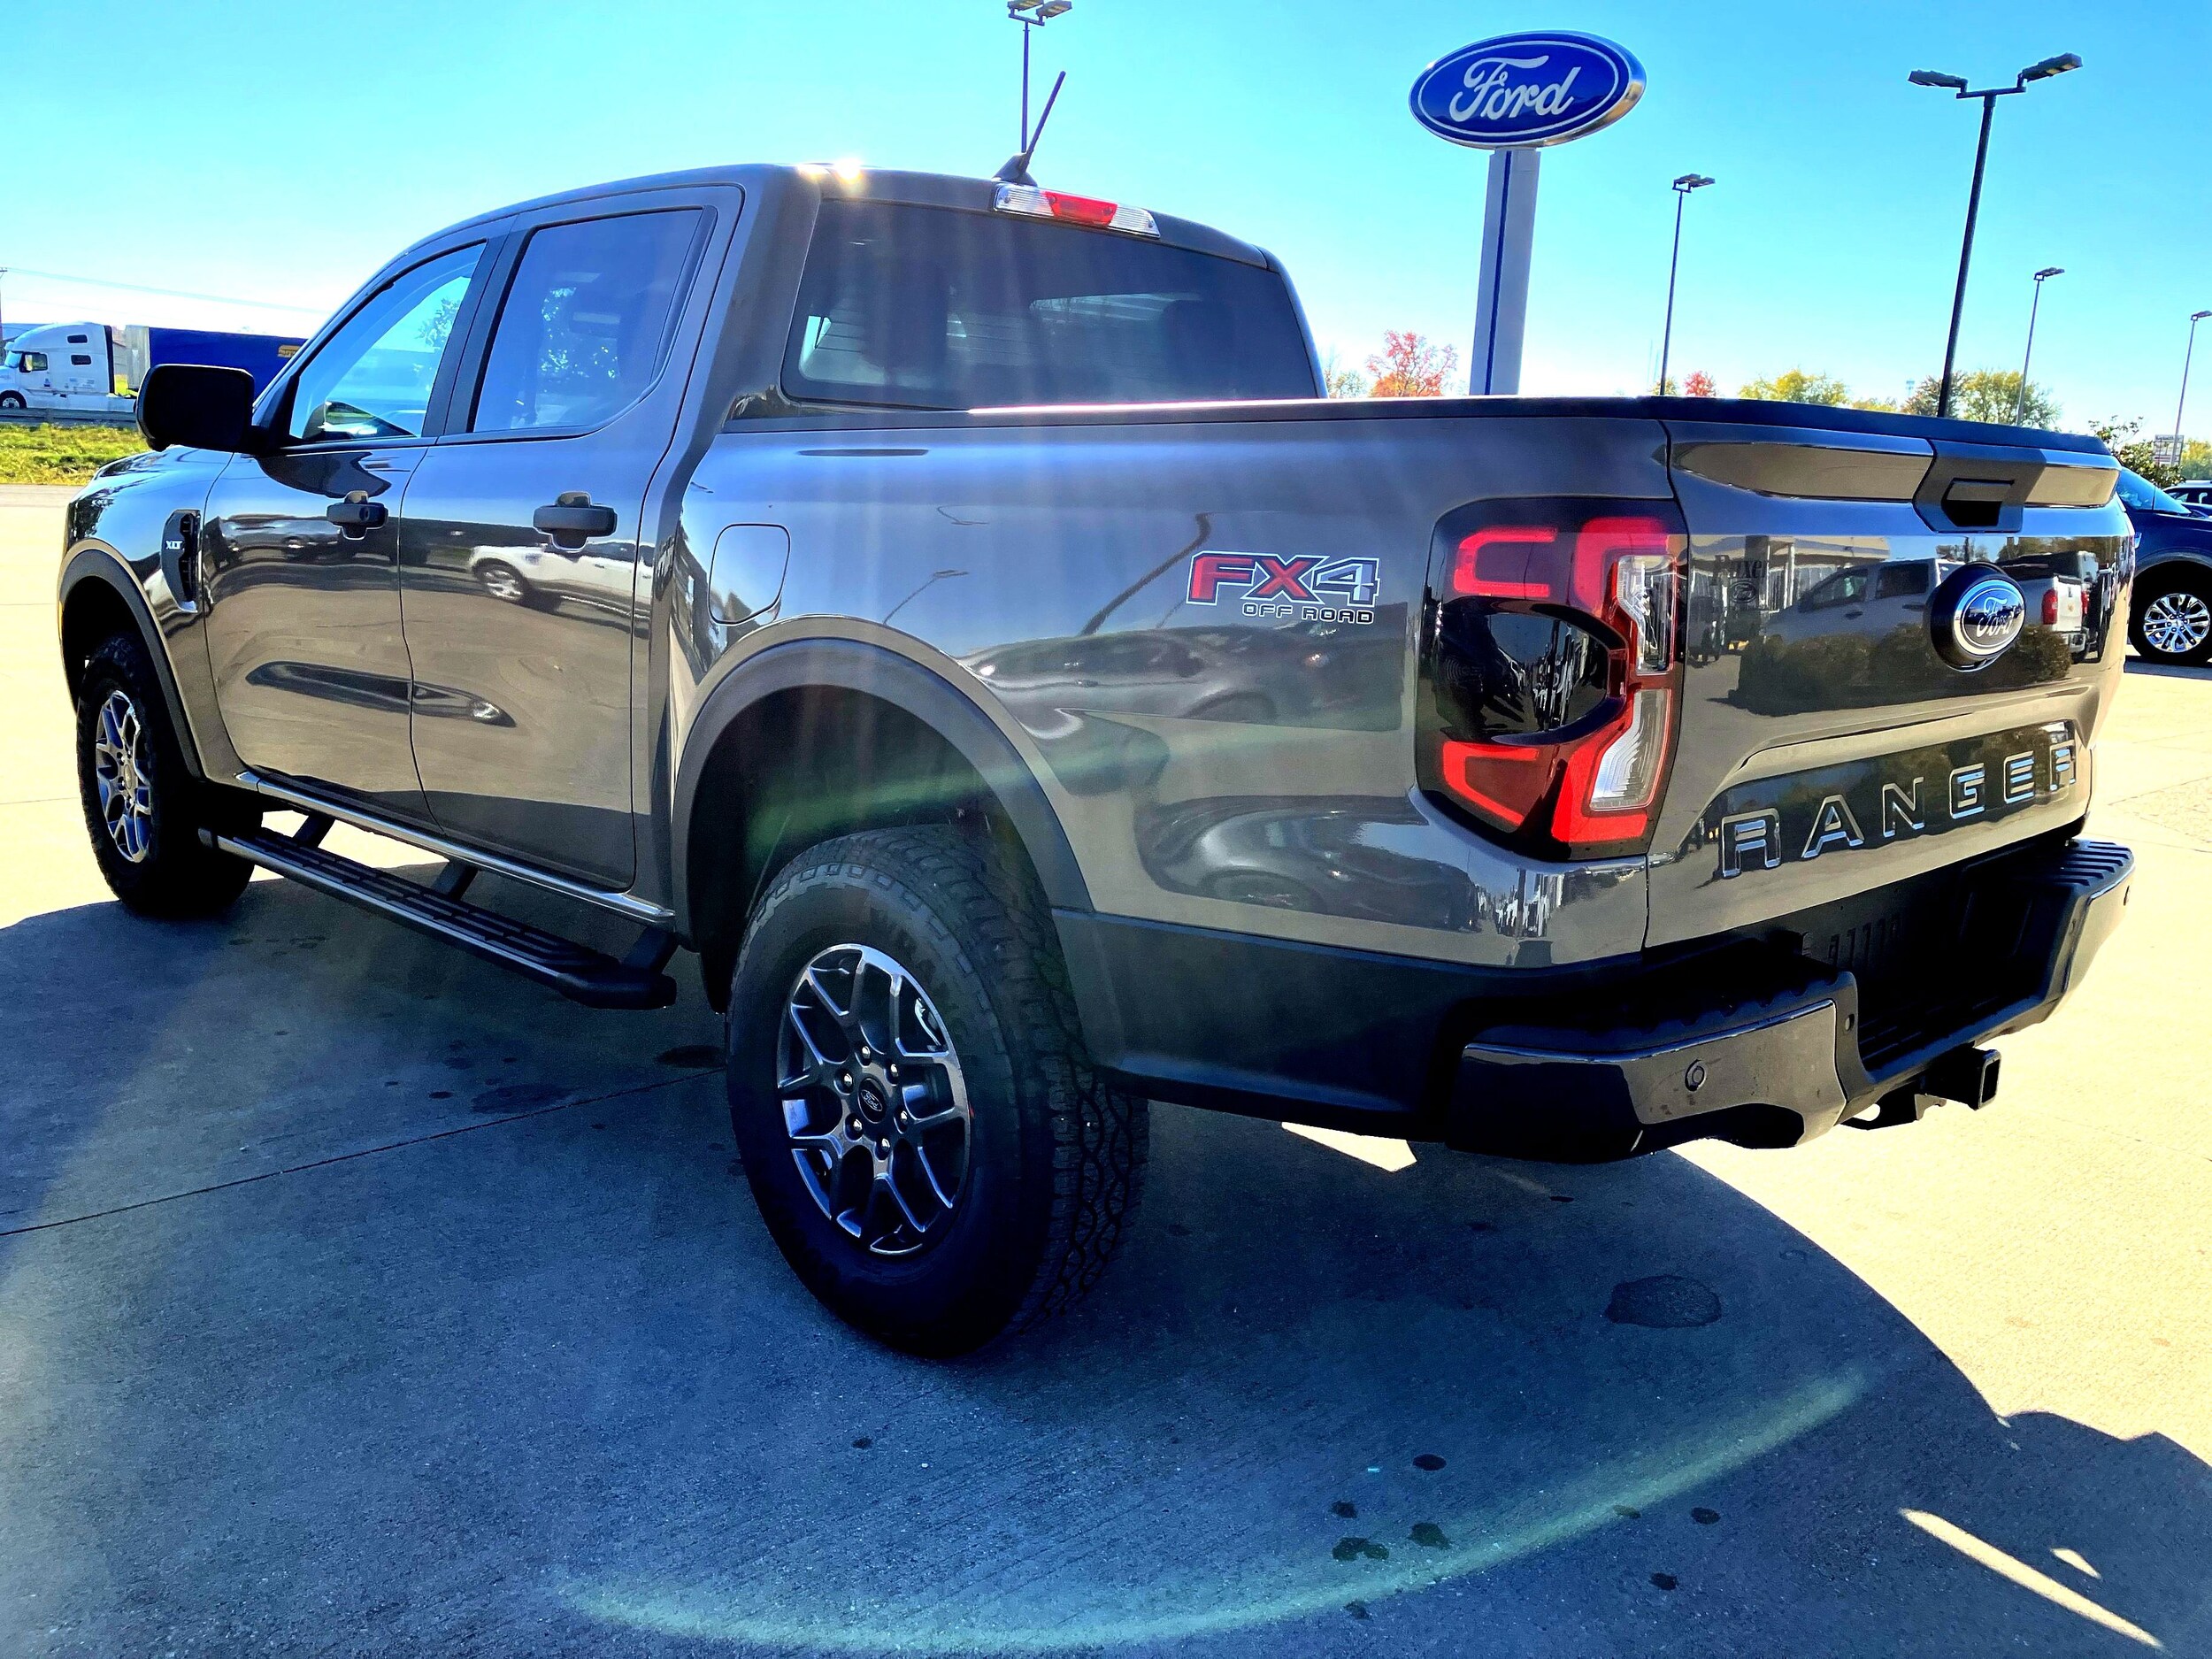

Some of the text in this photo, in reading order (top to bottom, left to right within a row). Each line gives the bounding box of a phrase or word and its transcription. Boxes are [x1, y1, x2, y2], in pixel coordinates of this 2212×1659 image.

[1449, 55, 1582, 122] Ford
[165, 540, 182, 549] XLT
[1186, 550, 1380, 607] FX4
[1241, 603, 1374, 625] OFF ROAD
[1976, 596, 2015, 638] Ford
[1721, 740, 2076, 879] RANGER
[863, 1091, 879, 1110] Ford
